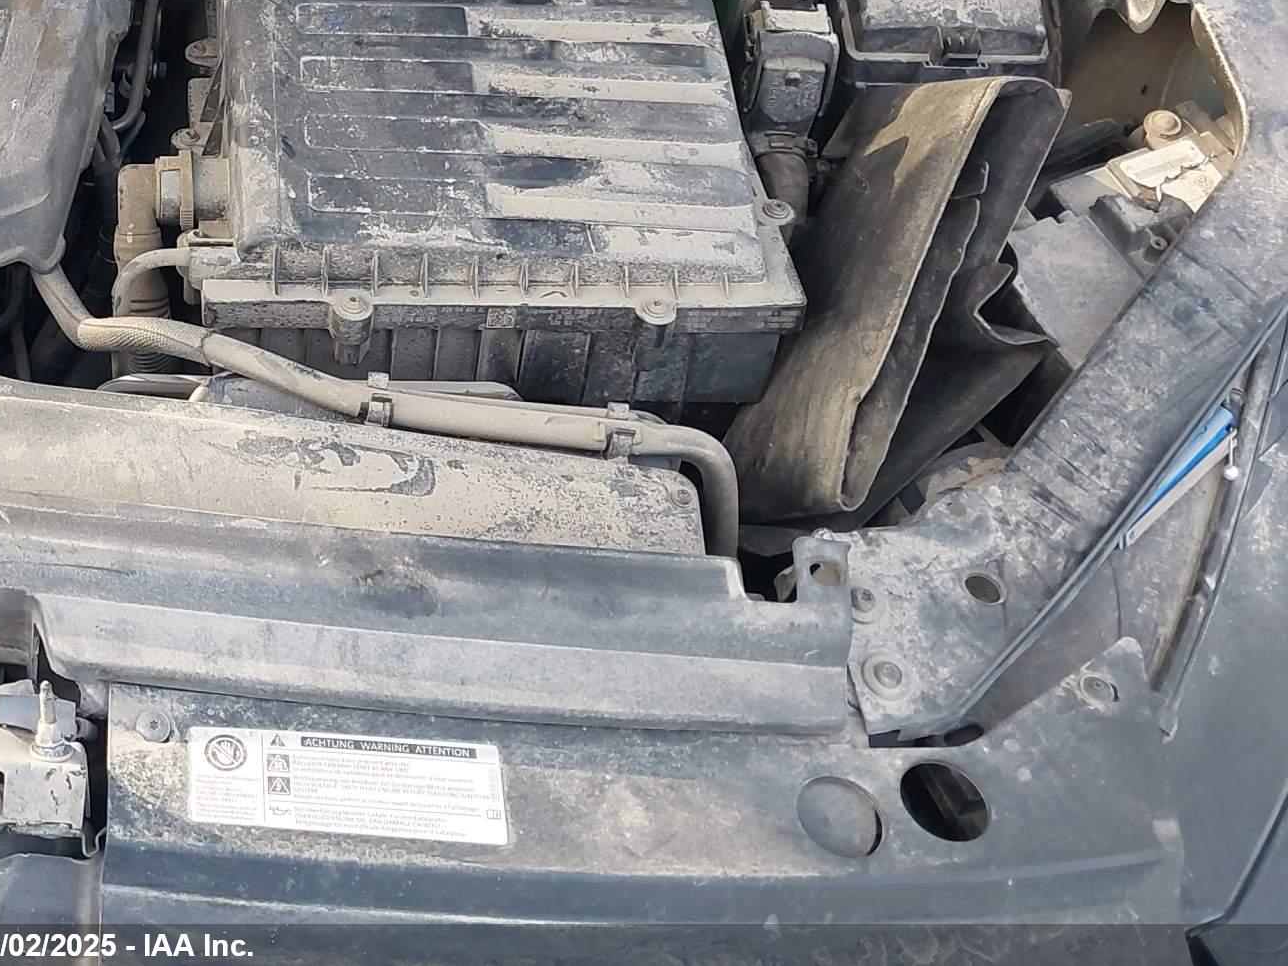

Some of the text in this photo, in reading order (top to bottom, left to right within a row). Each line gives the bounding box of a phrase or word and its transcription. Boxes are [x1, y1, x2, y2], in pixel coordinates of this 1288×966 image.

[305, 738, 470, 757] ACHTUNG WARNING ATTENTION
